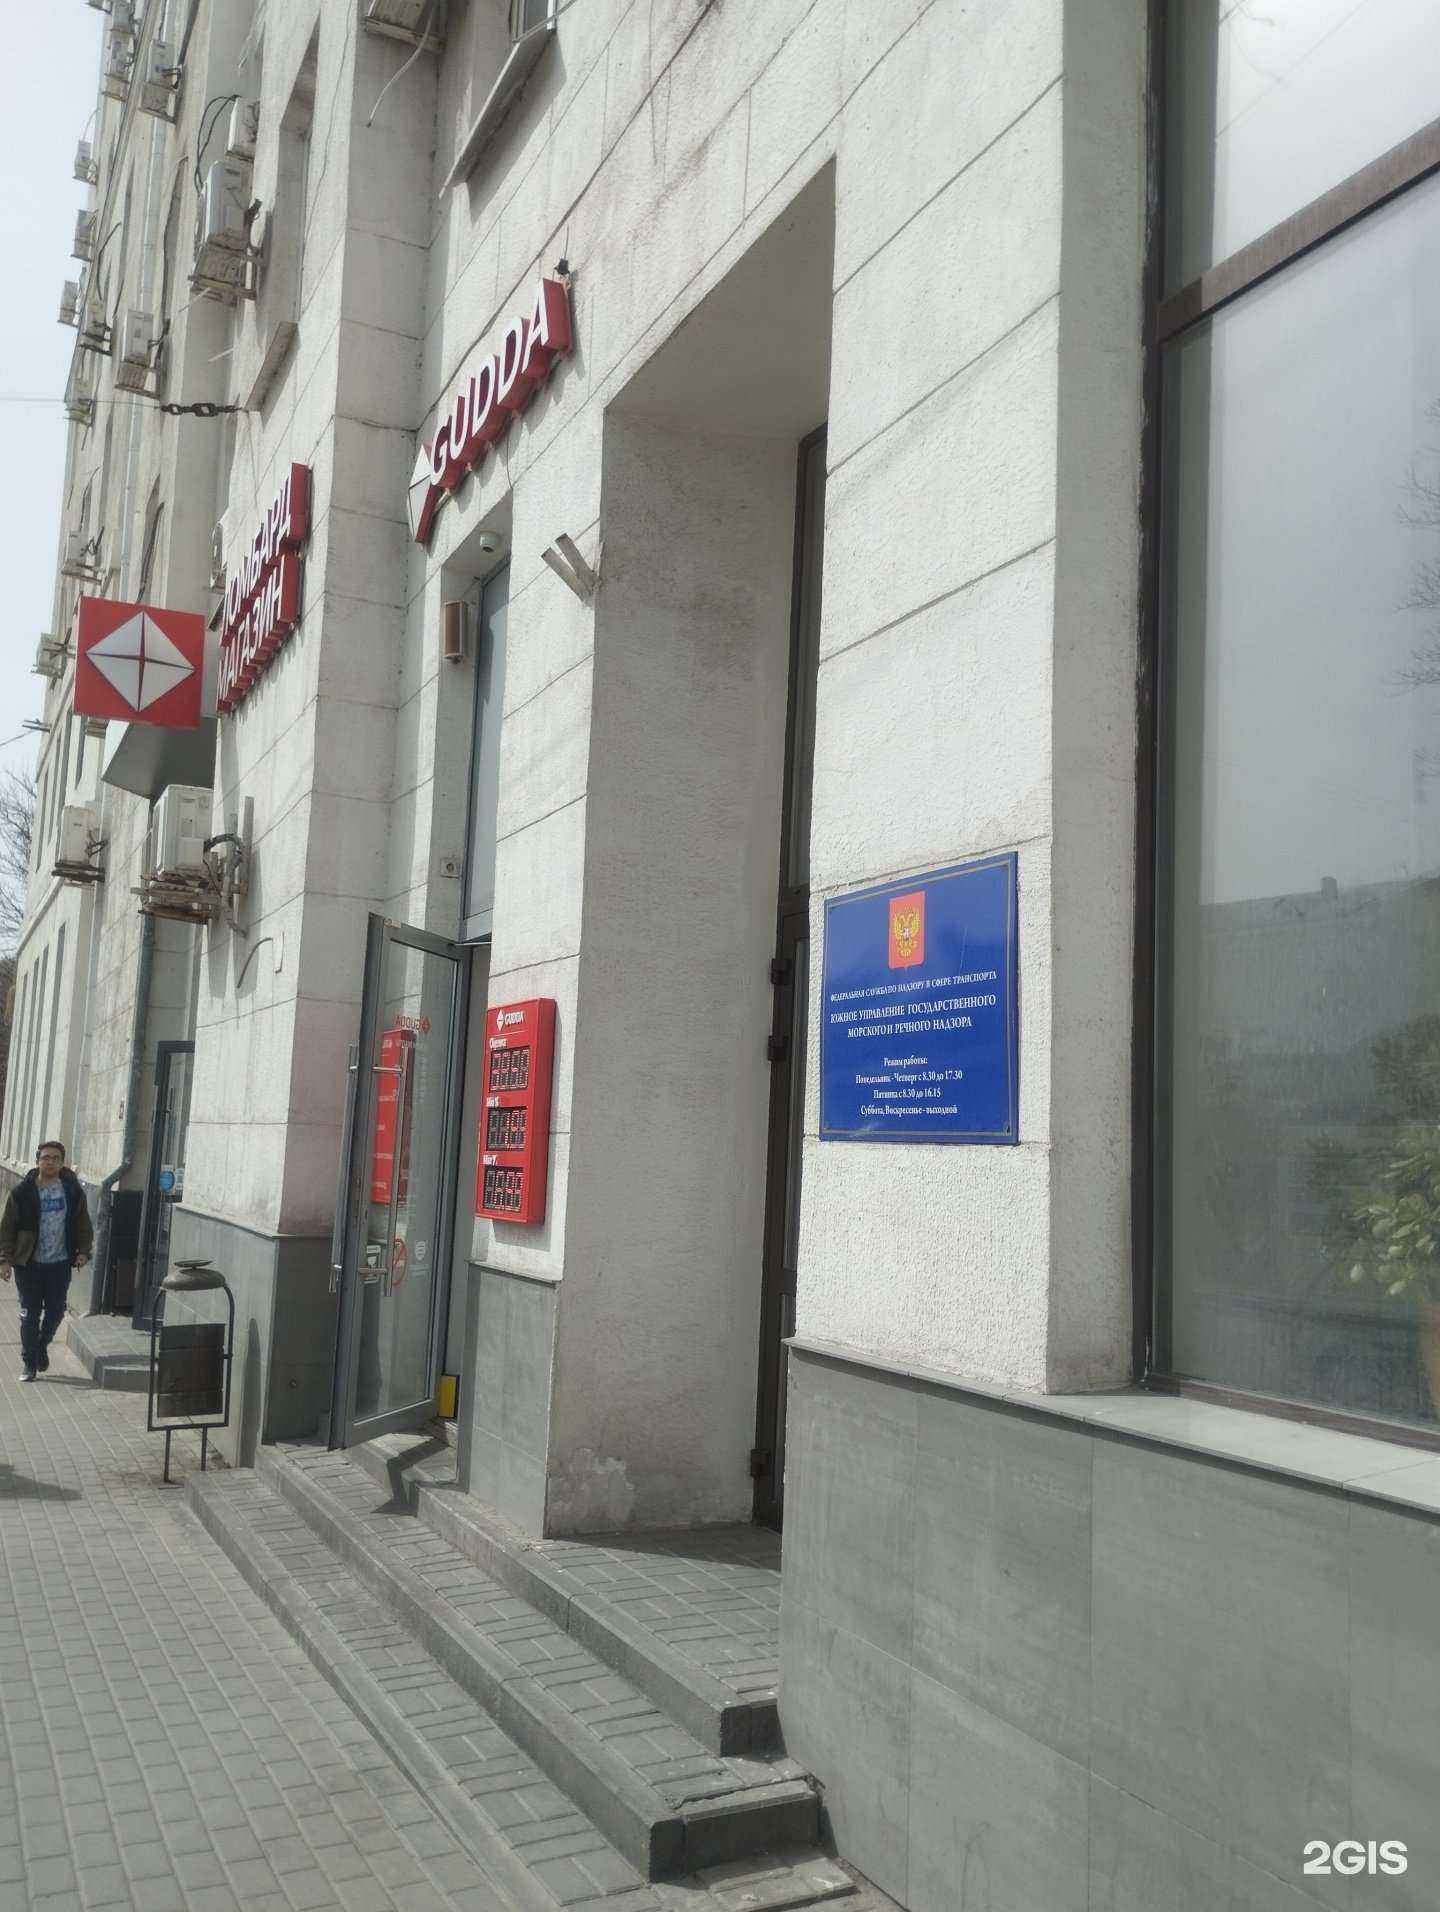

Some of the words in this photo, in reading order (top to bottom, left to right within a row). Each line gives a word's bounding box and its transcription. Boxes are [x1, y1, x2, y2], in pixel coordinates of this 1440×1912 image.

[430, 278, 550, 486] GUDDA
[219, 463, 293, 647] ЛОМБАРД
[216, 553, 286, 711] МАГАЗИН
[831, 990, 865, 1002] ФЕДЕРАЛЬНАЯ
[865, 986, 887, 998] СЛУЖБА
[898, 981, 924, 993] НАДЗОРУ
[931, 976, 952, 989] СФЕРЕ
[952, 970, 997, 985] ТРАНСПОРТА
[830, 1010, 858, 1024] ЮЖНОЕ
[859, 1005, 905, 1021] УПРАВЛЕНИЕ
[908, 994, 996, 1015] ГОСУДАРСТВЕННОГО
[848, 1024, 886, 1038] МОРСКОГО
[887, 1024, 893, 1035] И
[895, 1020, 931, 1034] РЕЧНОГО
[933, 1016, 972, 1031] НАДЗОРА
[894, 1072, 917, 1084] Четверг
[922, 1071, 936, 1081] 8.30
[945, 1070, 963, 1080] 17.30
[902, 1088, 915, 1098] 8.30
[924, 1087, 941, 1098] 16.15
[885, 1105, 922, 1117] Воскресенье
